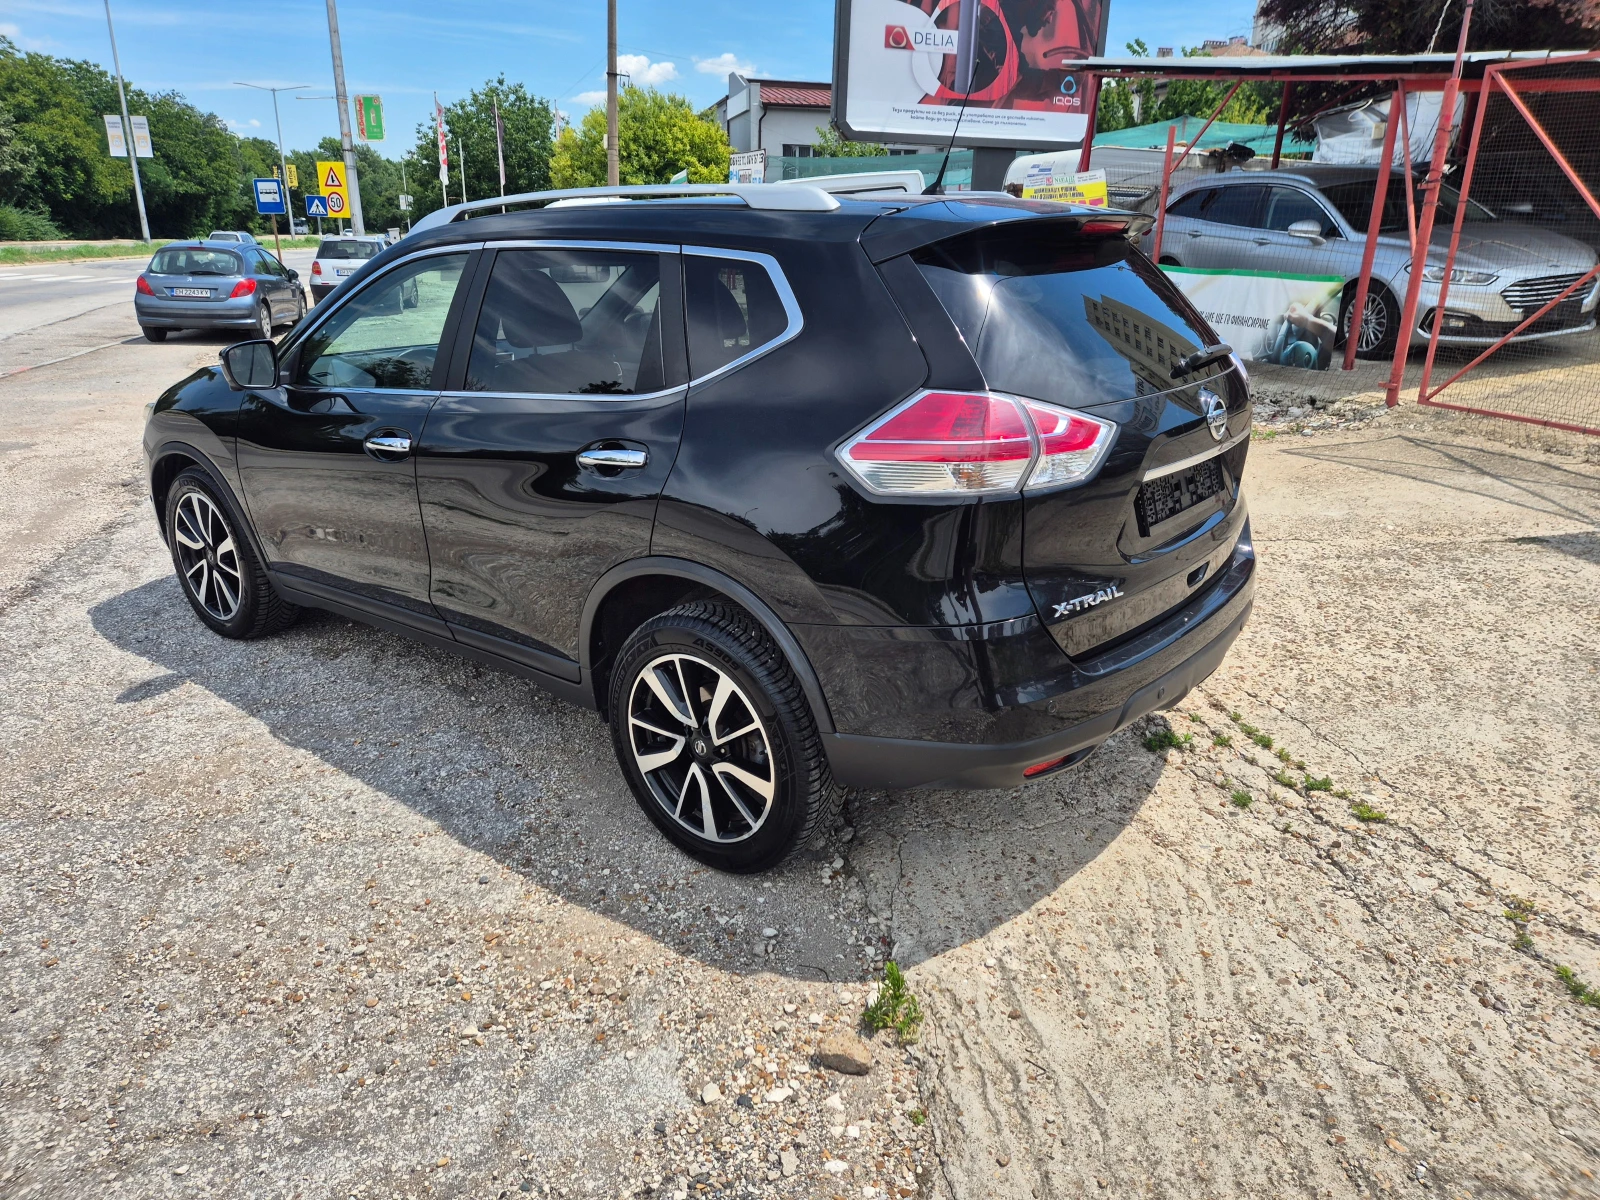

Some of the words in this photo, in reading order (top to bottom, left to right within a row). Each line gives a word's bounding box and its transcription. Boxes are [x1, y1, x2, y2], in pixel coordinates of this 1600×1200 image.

[914, 31, 954, 47] DELIA
[1053, 96, 1081, 106] IQOS
[330, 197, 341, 208] 50
[1215, 313, 1225, 325] ЩЕ
[1230, 315, 1271, 330] ФИНАНСИРАМЕ
[1052, 585, 1124, 618] X-TRAIL
[692, 637, 740, 671] AS909
